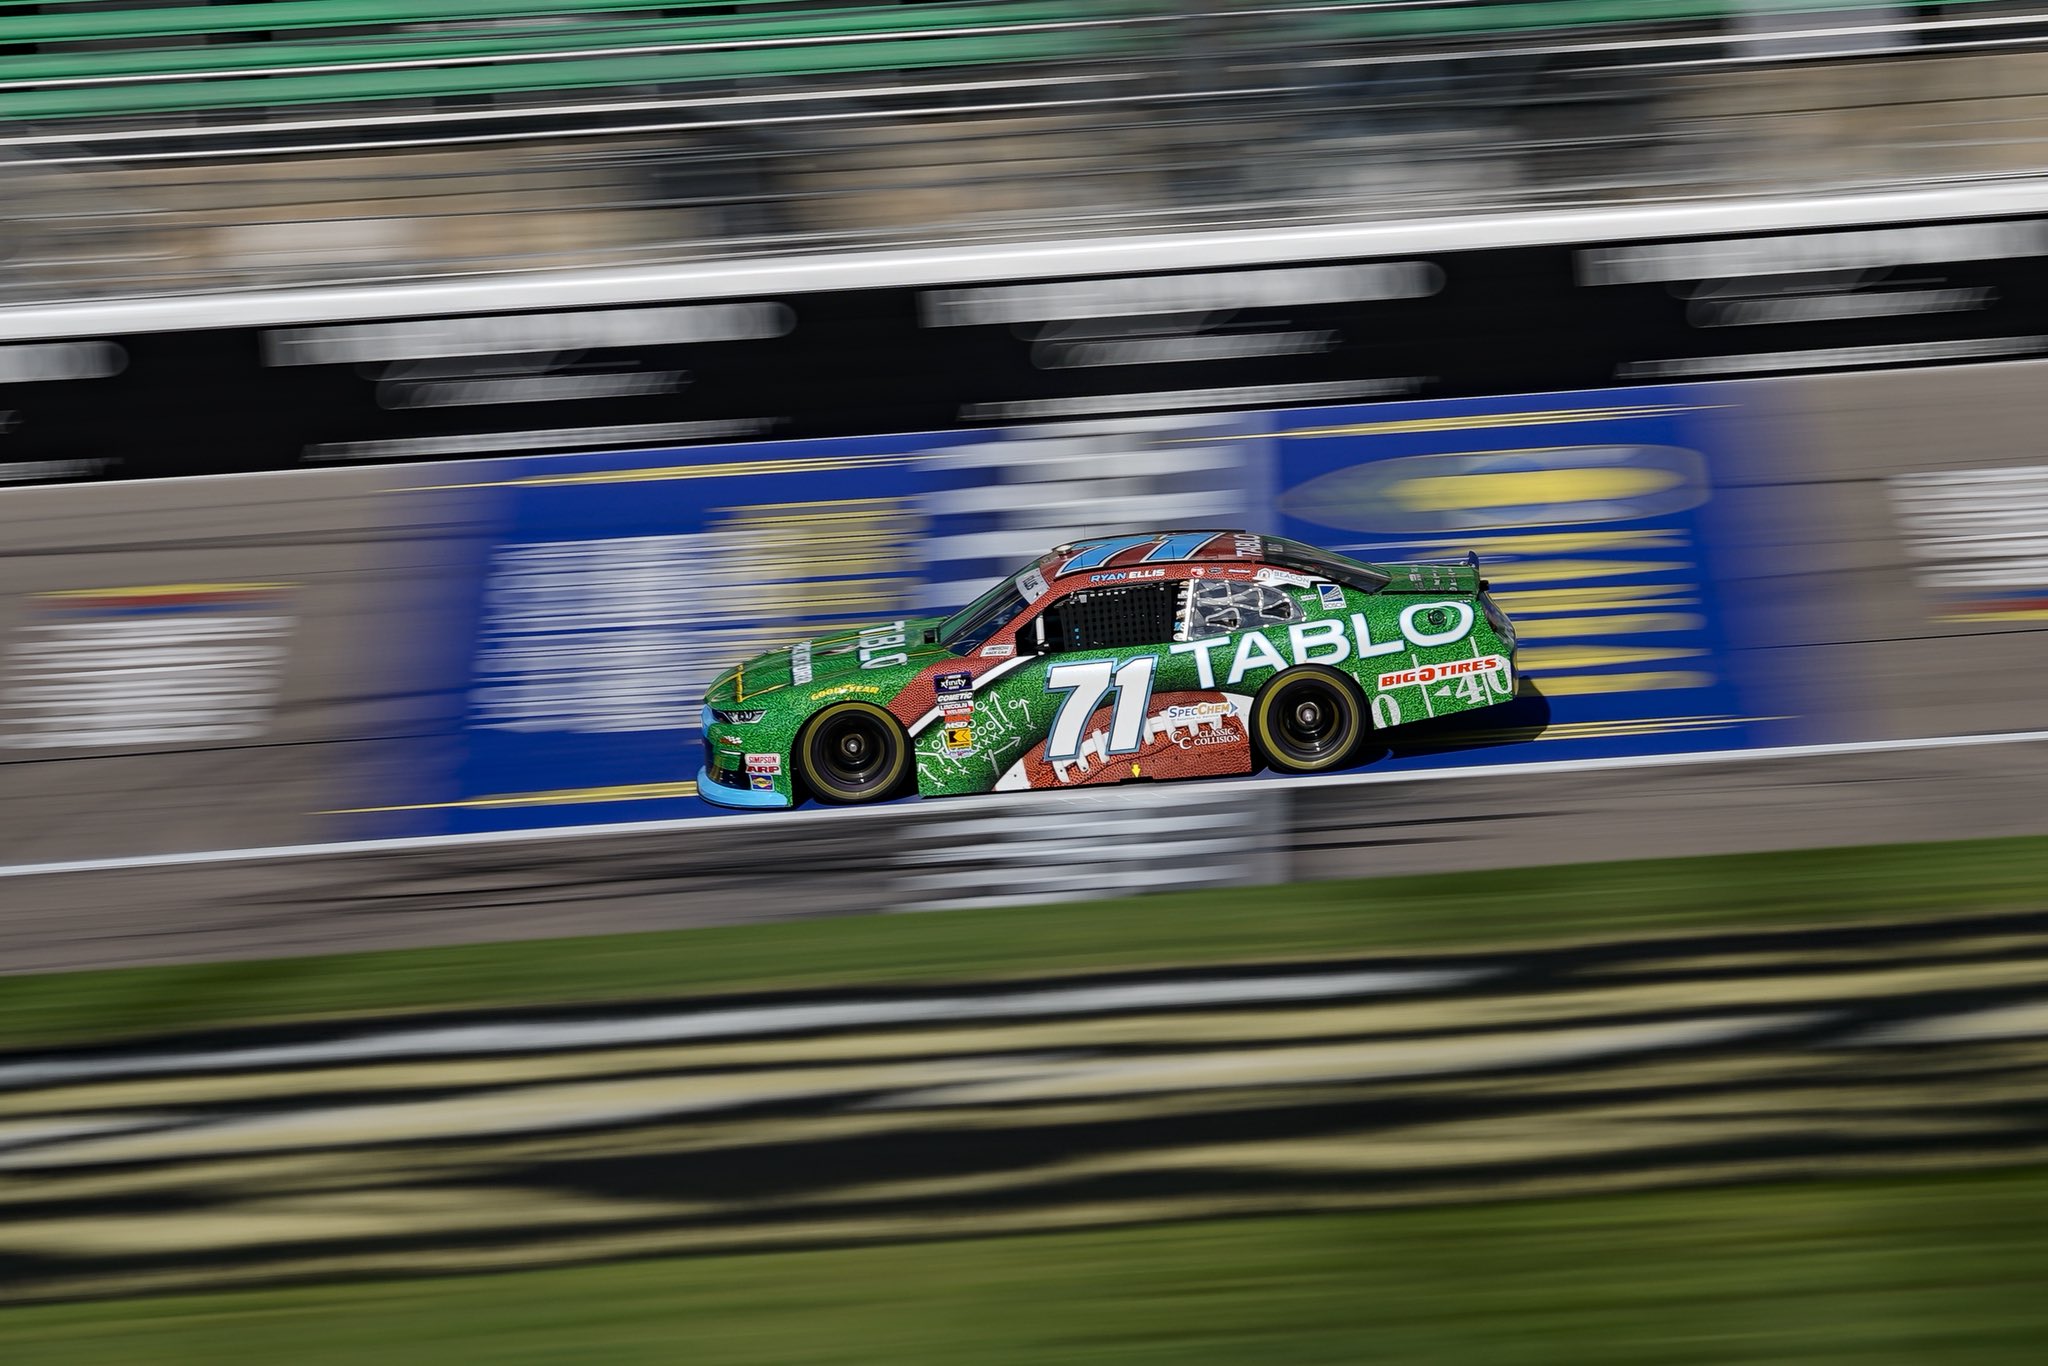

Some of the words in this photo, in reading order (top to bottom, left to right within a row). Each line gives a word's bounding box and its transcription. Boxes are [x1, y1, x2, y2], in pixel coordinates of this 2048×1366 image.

[1234, 534, 1262, 557] TABLO
[1090, 572, 1126, 583] RYAN
[1128, 568, 1165, 579] ELLIS
[1273, 571, 1310, 583] BEACON
[858, 620, 908, 669] TBLO
[1170, 600, 1474, 689] TABLO
[1381, 672, 1416, 687] BIG
[1437, 658, 1497, 676] TIRES
[940, 679, 967, 689] xfinity
[811, 684, 880, 700] GOODYEAR
[937, 692, 973, 703] COMETIC
[1044, 655, 1160, 761] 71
[1371, 694, 1401, 730] 0
[945, 721, 968, 729] MSD
[1194, 735, 1240, 746] COLLISION
[1199, 728, 1235, 738] CLASSIC
[748, 756, 777, 764] SIMPSON
